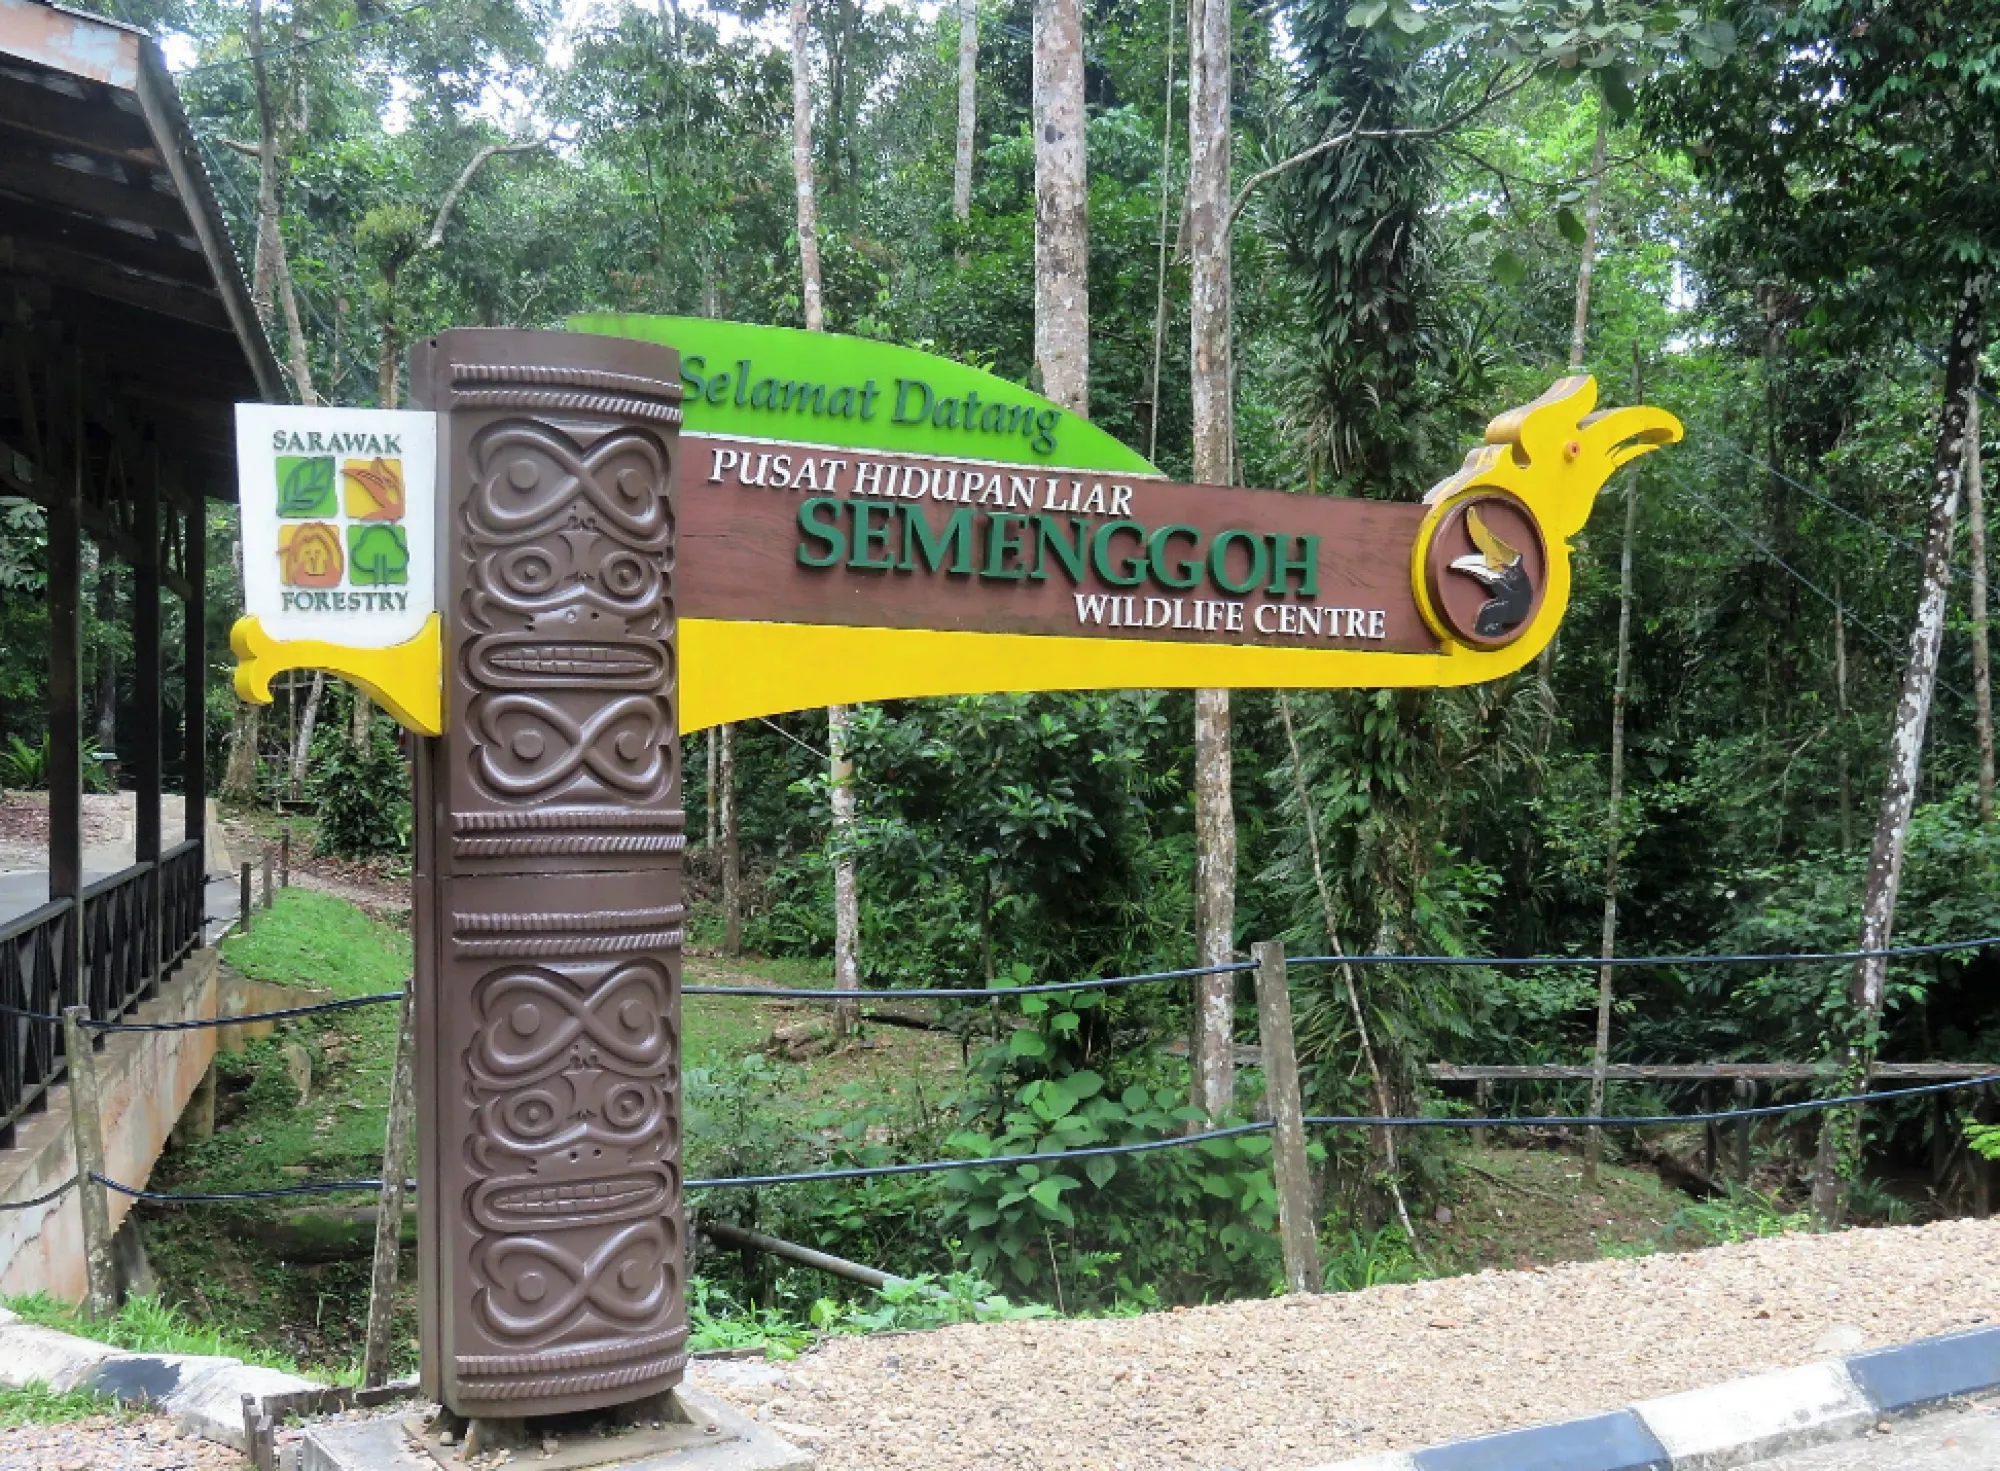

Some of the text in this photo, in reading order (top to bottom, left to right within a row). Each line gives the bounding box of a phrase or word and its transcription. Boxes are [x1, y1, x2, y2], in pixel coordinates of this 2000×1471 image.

[679, 355, 1062, 455] Selamat Datang
[273, 430, 402, 453] SARAWAK
[708, 447, 1134, 516] PUSAT HIDUPAN LIAR
[796, 496, 1324, 597] SEMENGGOH
[281, 591, 409, 612] FORESTRY
[1073, 593, 1386, 640] WILDLIFE CENTRE
